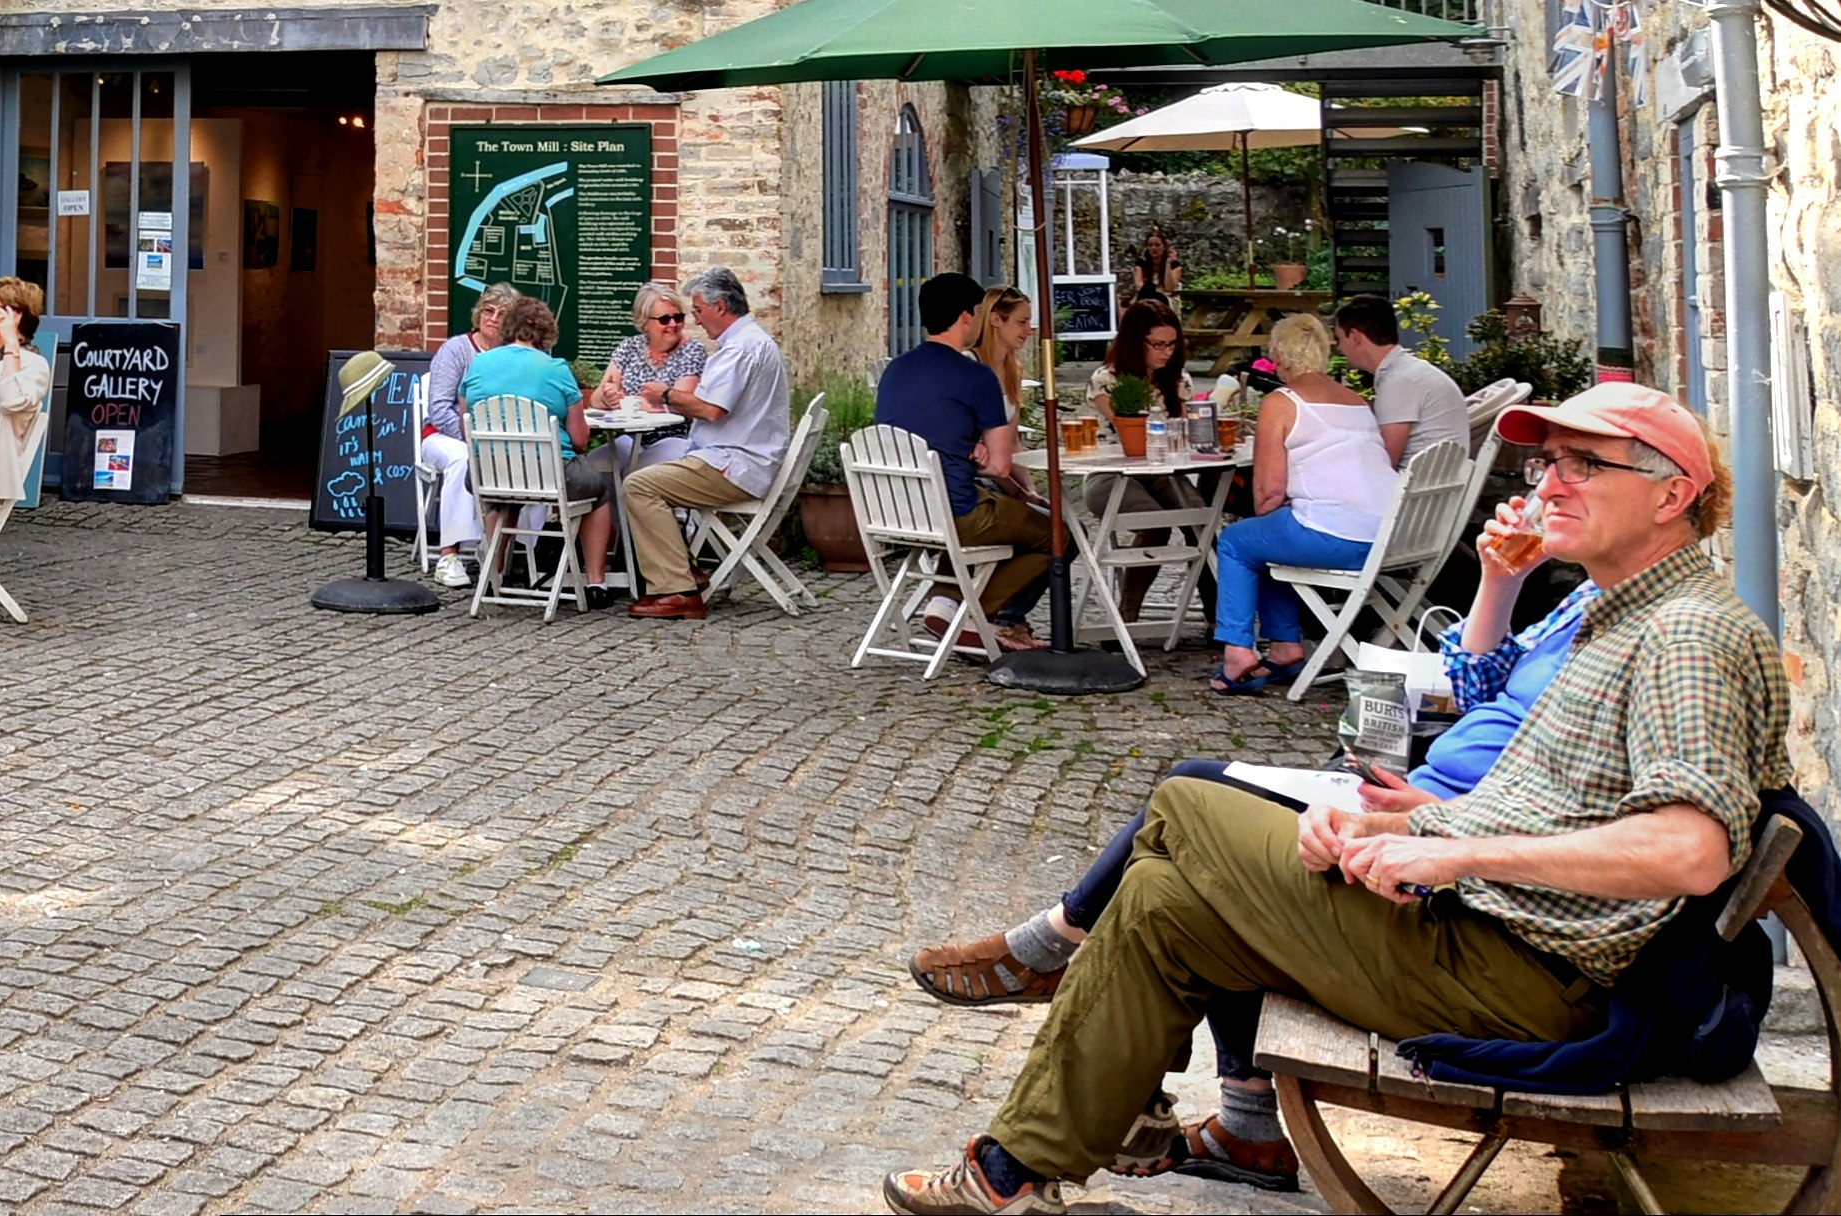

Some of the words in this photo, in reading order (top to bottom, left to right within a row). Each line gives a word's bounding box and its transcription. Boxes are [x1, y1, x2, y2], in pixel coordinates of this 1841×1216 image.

[476, 141, 499, 153] The
[501, 141, 534, 153] Town
[537, 141, 560, 153] Mill
[571, 141, 595, 153] Site
[597, 141, 625, 153] Plan
[63, 204, 84, 212] OPEN
[73, 341, 169, 372] COURTYARD
[84, 373, 164, 406] GALLERY
[91, 403, 141, 427] OPEN
[386, 465, 414, 482] COSY
[1364, 700, 1405, 720] BURTS
[1363, 717, 1405, 734] BRITISH
